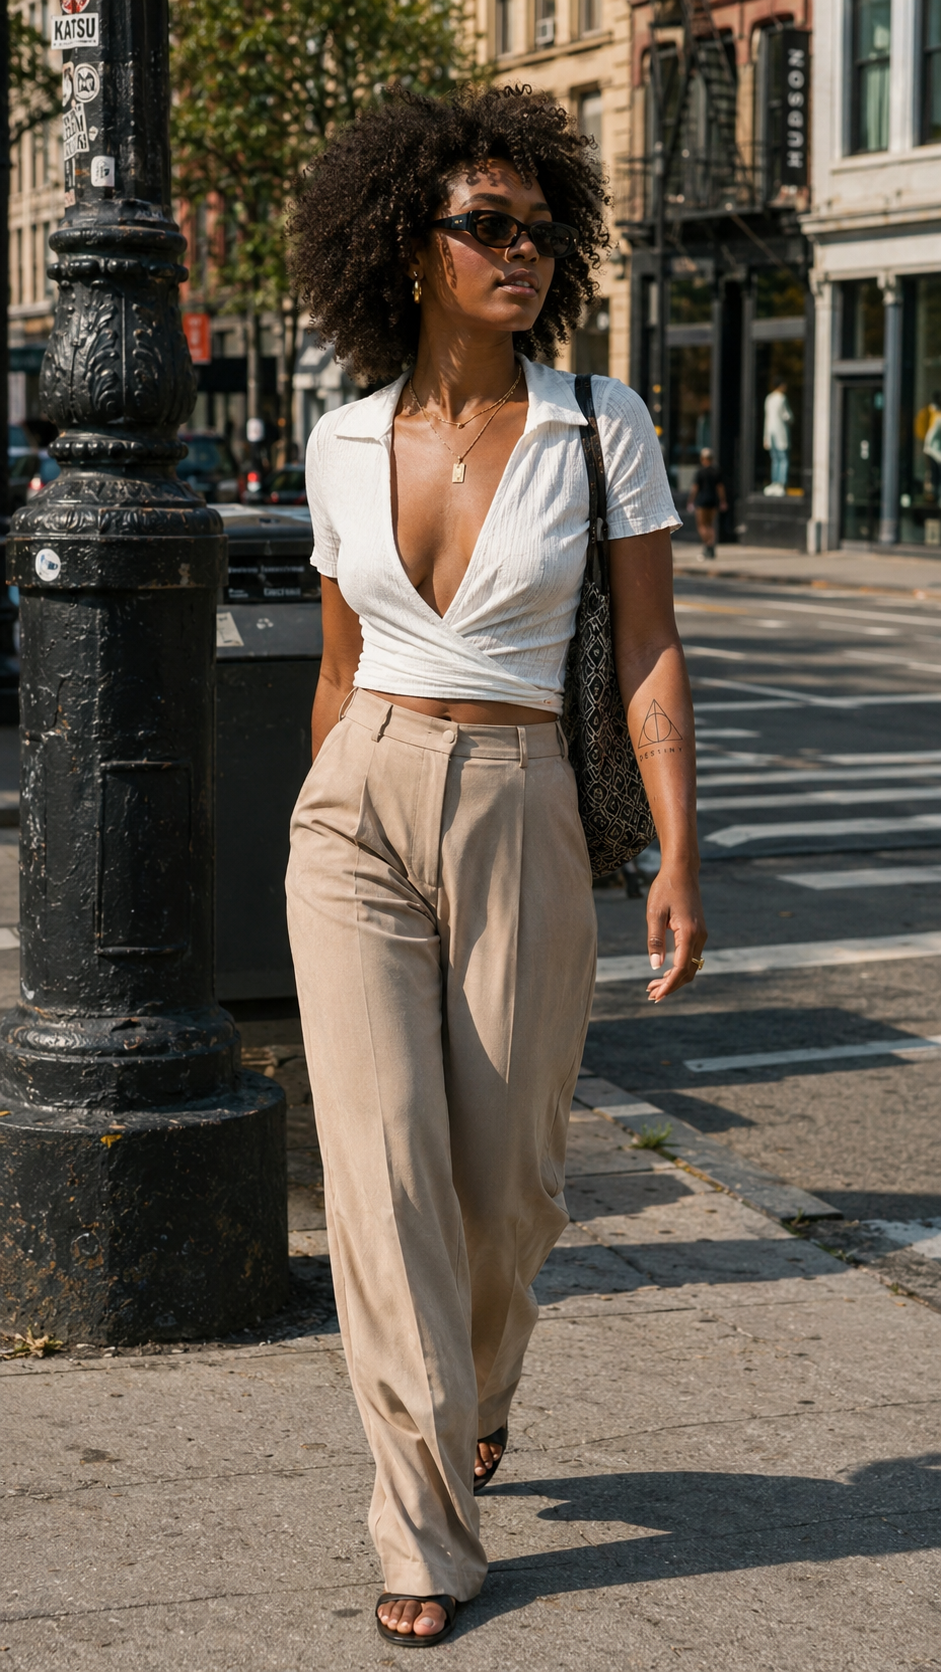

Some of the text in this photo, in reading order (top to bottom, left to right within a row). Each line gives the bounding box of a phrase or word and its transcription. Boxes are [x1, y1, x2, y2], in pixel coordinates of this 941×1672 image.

[54, 17, 96, 41] KATSU
[787, 48, 805, 169] HUDSON
[639, 747, 683, 762] DESTINY
